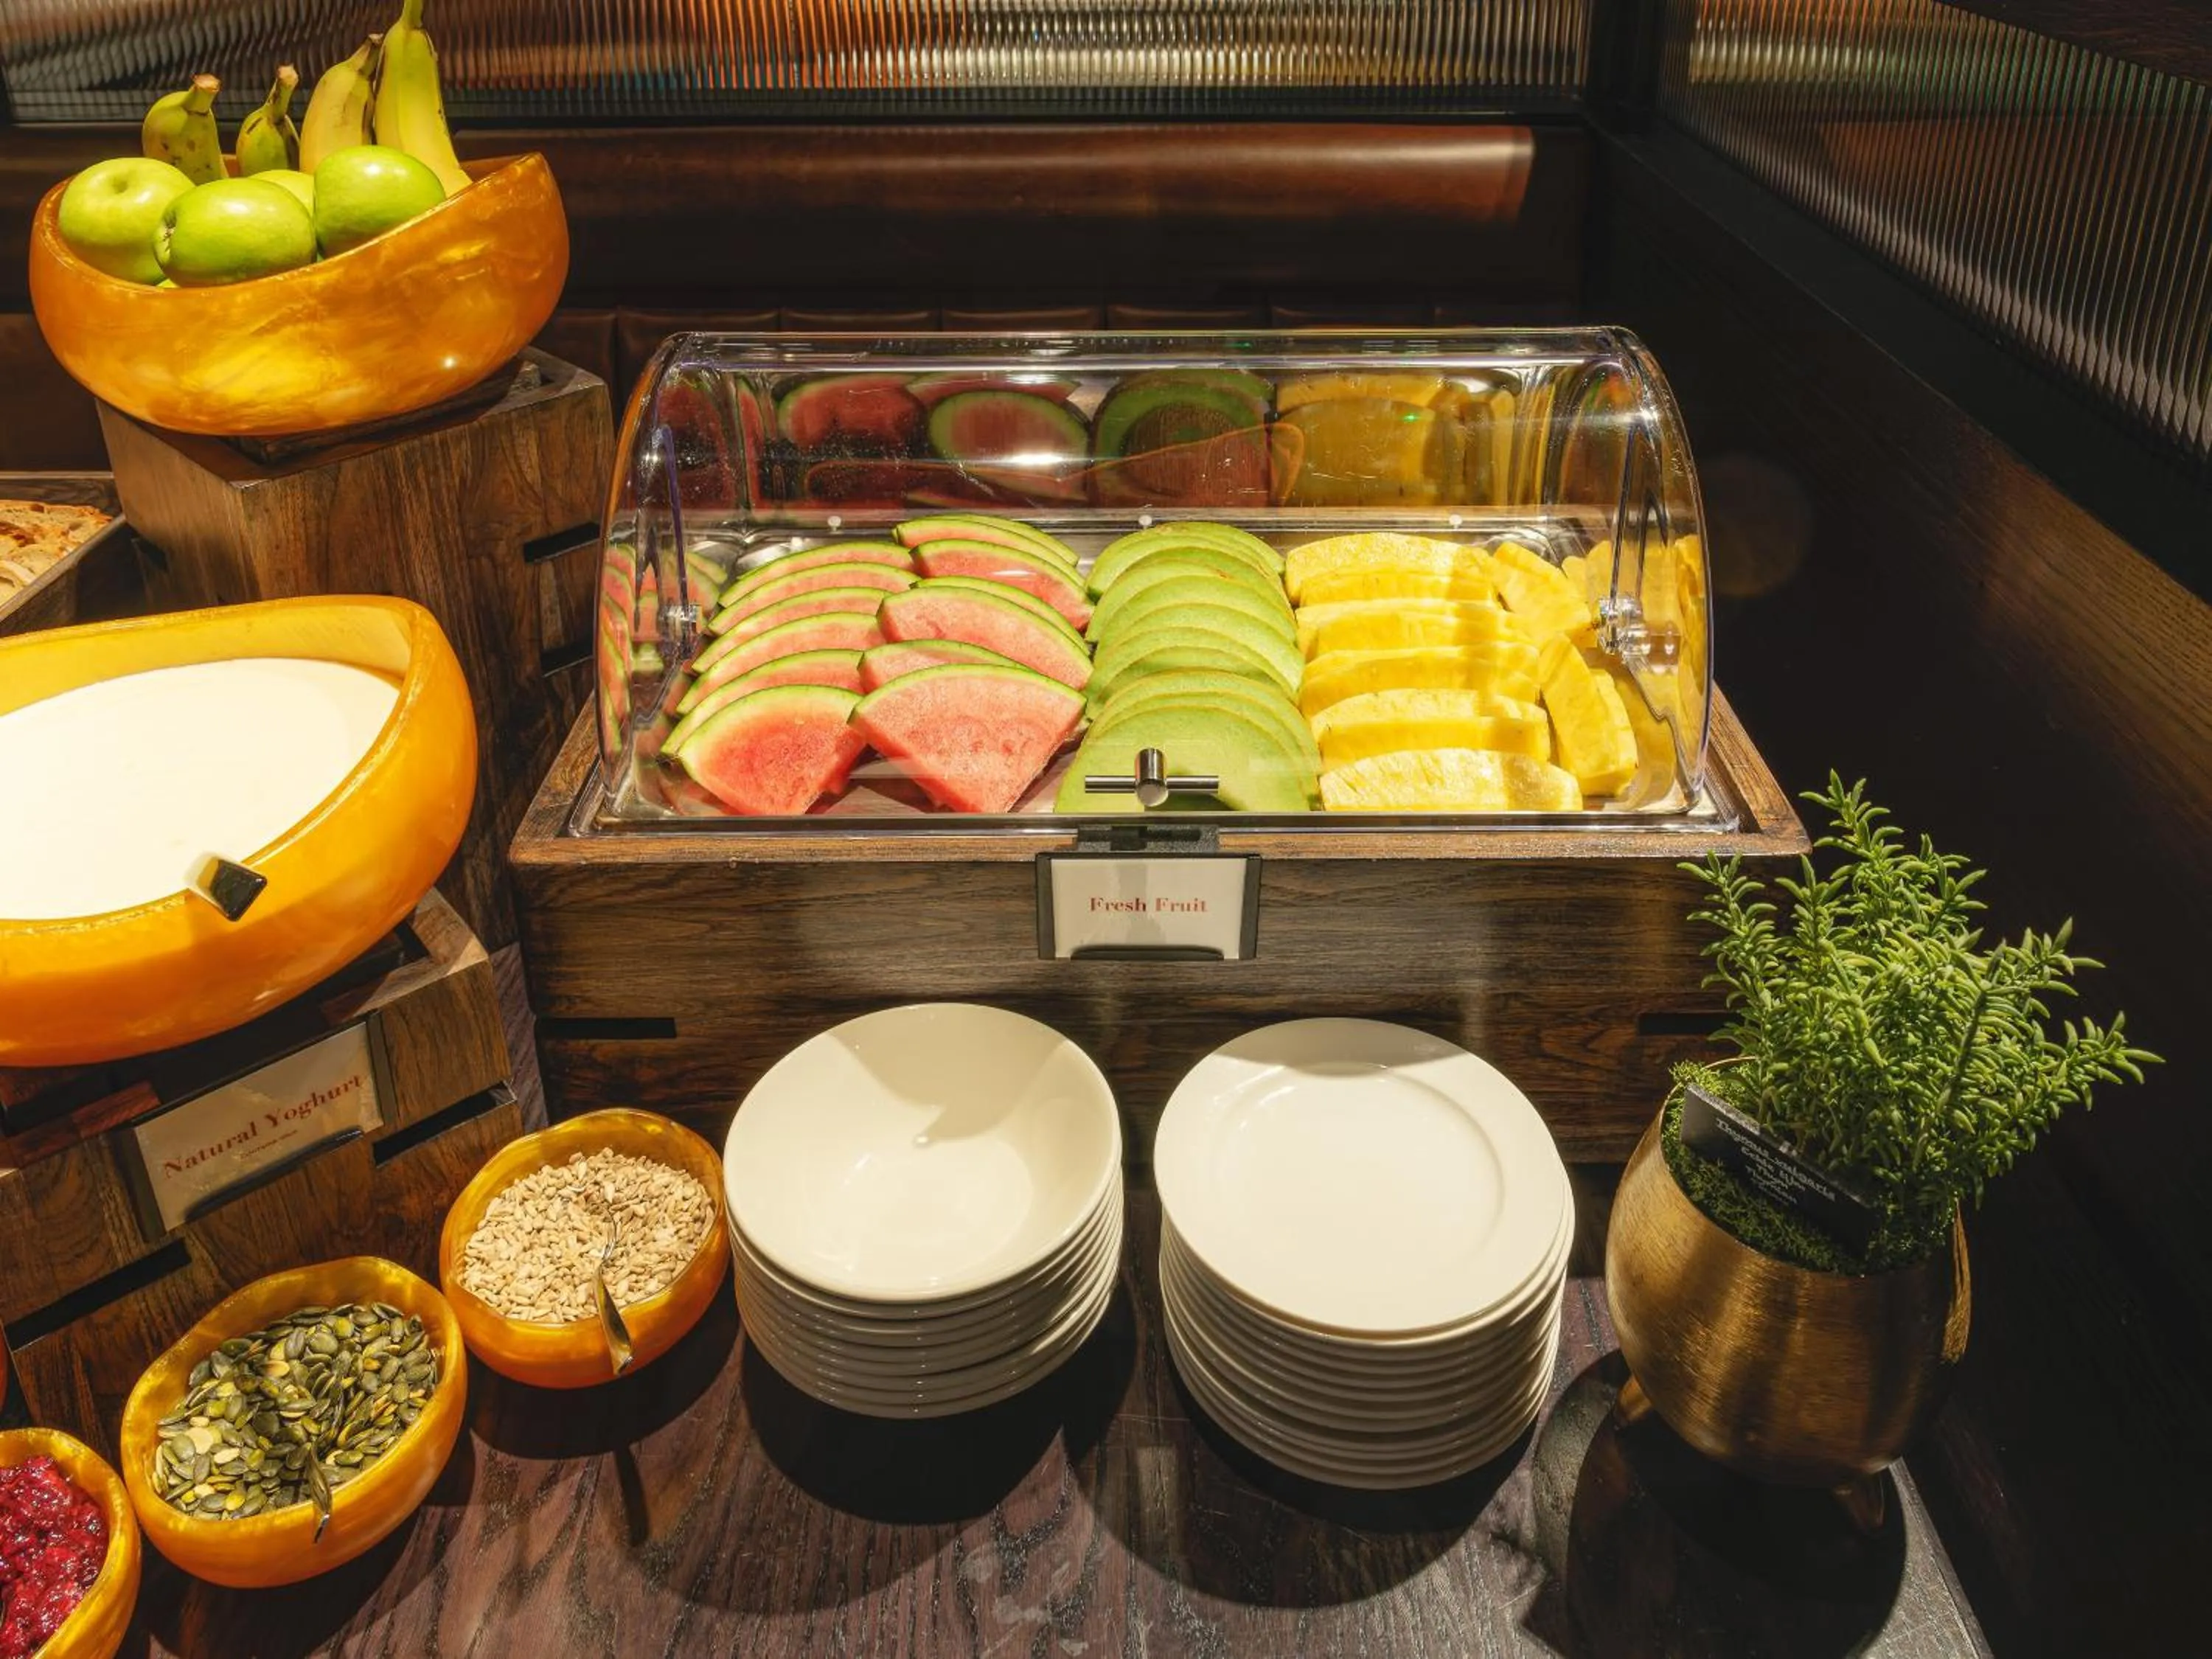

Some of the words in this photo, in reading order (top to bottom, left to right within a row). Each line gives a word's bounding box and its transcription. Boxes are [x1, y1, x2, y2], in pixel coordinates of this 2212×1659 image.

[1089, 897, 1147, 913] Fresh
[1155, 897, 1208, 913] Fruit
[164, 1121, 258, 1180] Natural
[263, 1074, 363, 1128] Yoghurt
